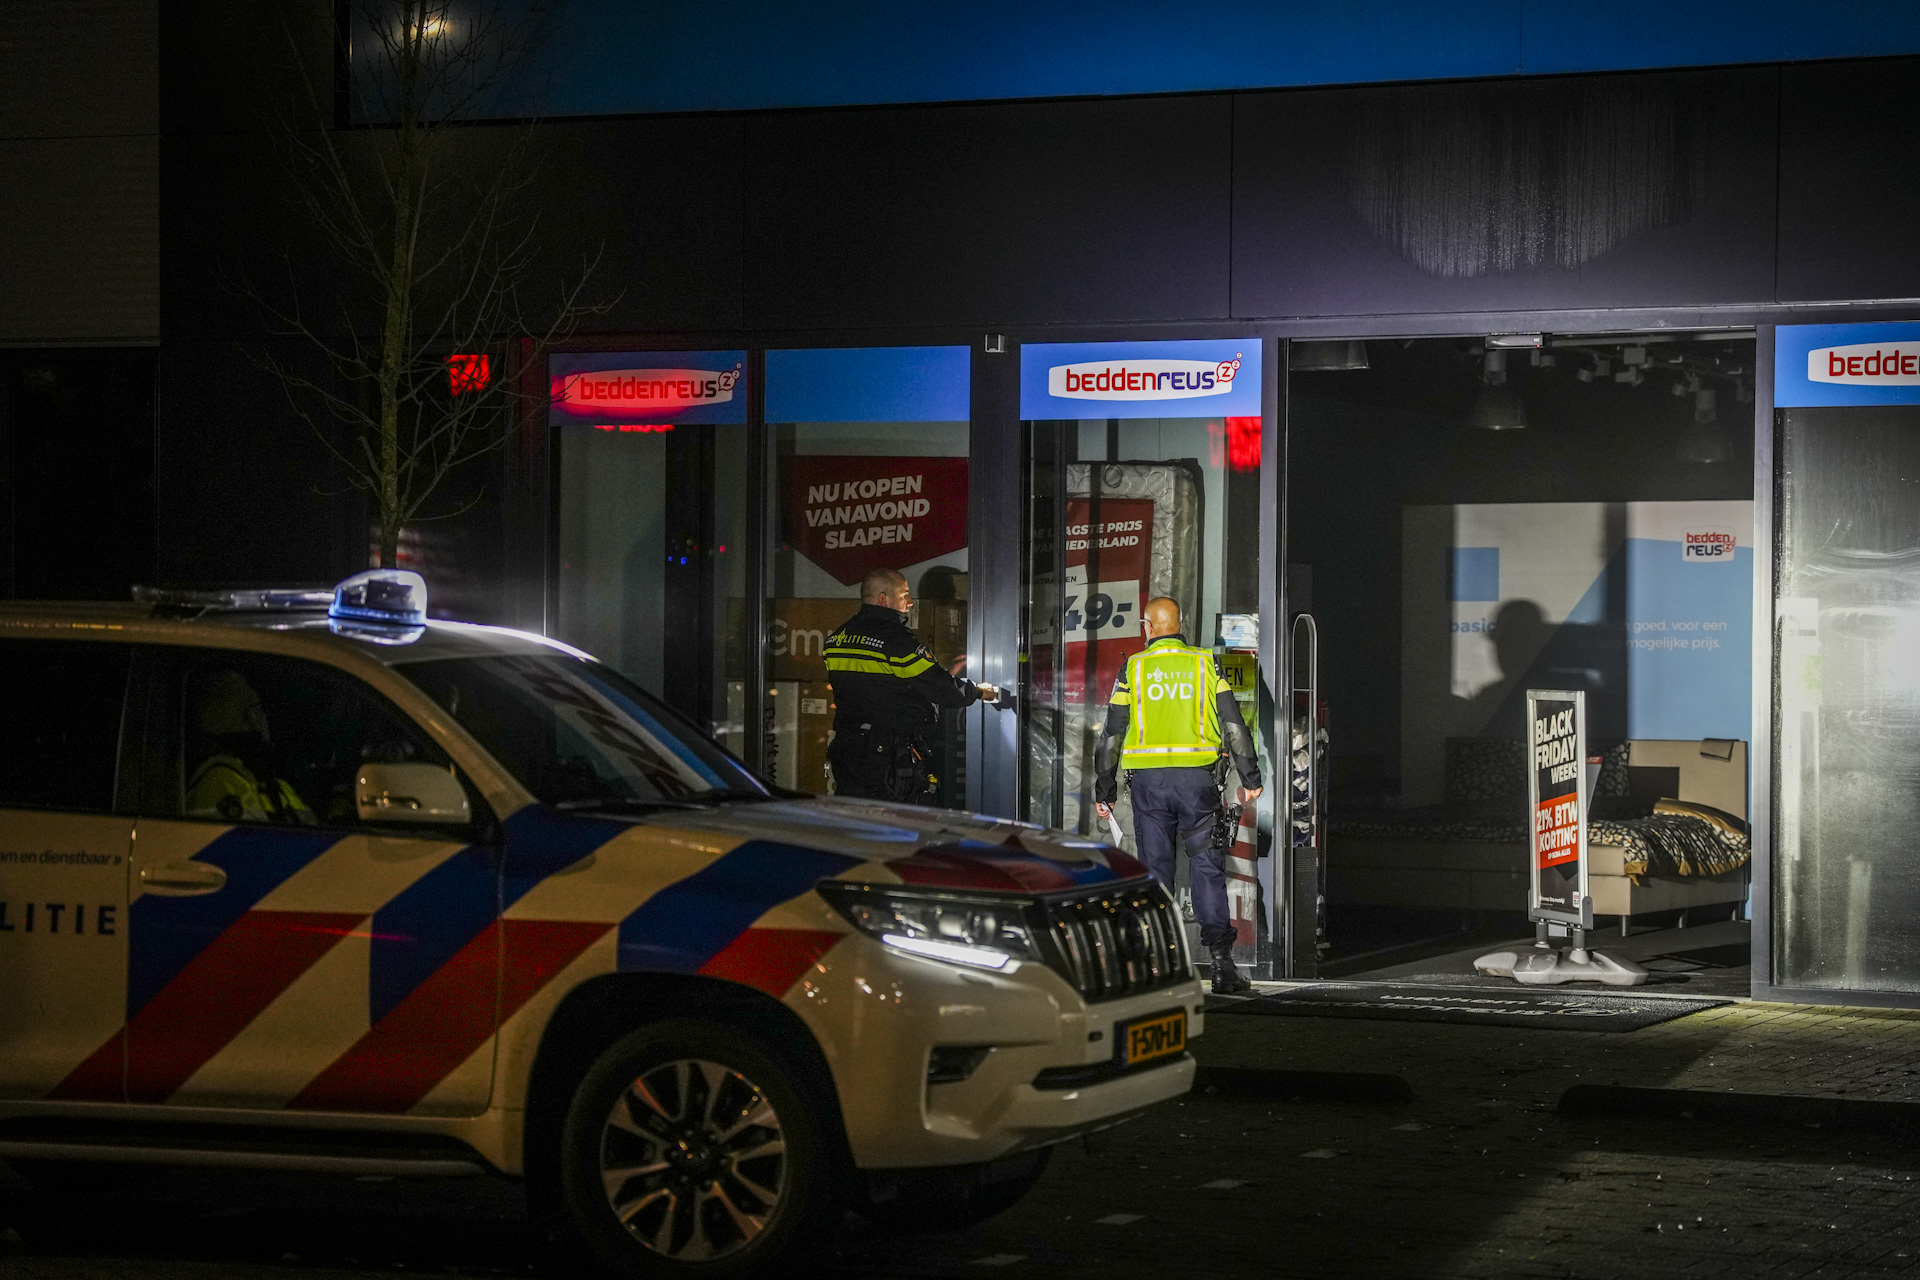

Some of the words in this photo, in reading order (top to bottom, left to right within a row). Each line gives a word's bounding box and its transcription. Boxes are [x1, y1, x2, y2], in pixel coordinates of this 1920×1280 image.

[1829, 350, 1920, 376] bedde
[808, 483, 840, 504] NU
[843, 475, 922, 501] KOPEN
[805, 498, 930, 528] VANAVOND
[824, 523, 914, 550] SLAPEN
[1107, 520, 1143, 533] PRIJS
[1633, 619, 1669, 633] goed,
[1672, 621, 1700, 631] voor
[1703, 621, 1728, 631] een
[1626, 636, 1689, 651] mogelijke
[1692, 636, 1721, 651] prijs.
[1147, 683, 1194, 700] OVD
[1536, 708, 1574, 746] BLACK
[1536, 734, 1576, 771] FRIDAY
[1550, 761, 1578, 785] WEEKS
[1536, 807, 1553, 833] 21%
[1555, 800, 1578, 828] BTW
[20, 853, 37, 863] en
[40, 850, 110, 865] dienstbaar
